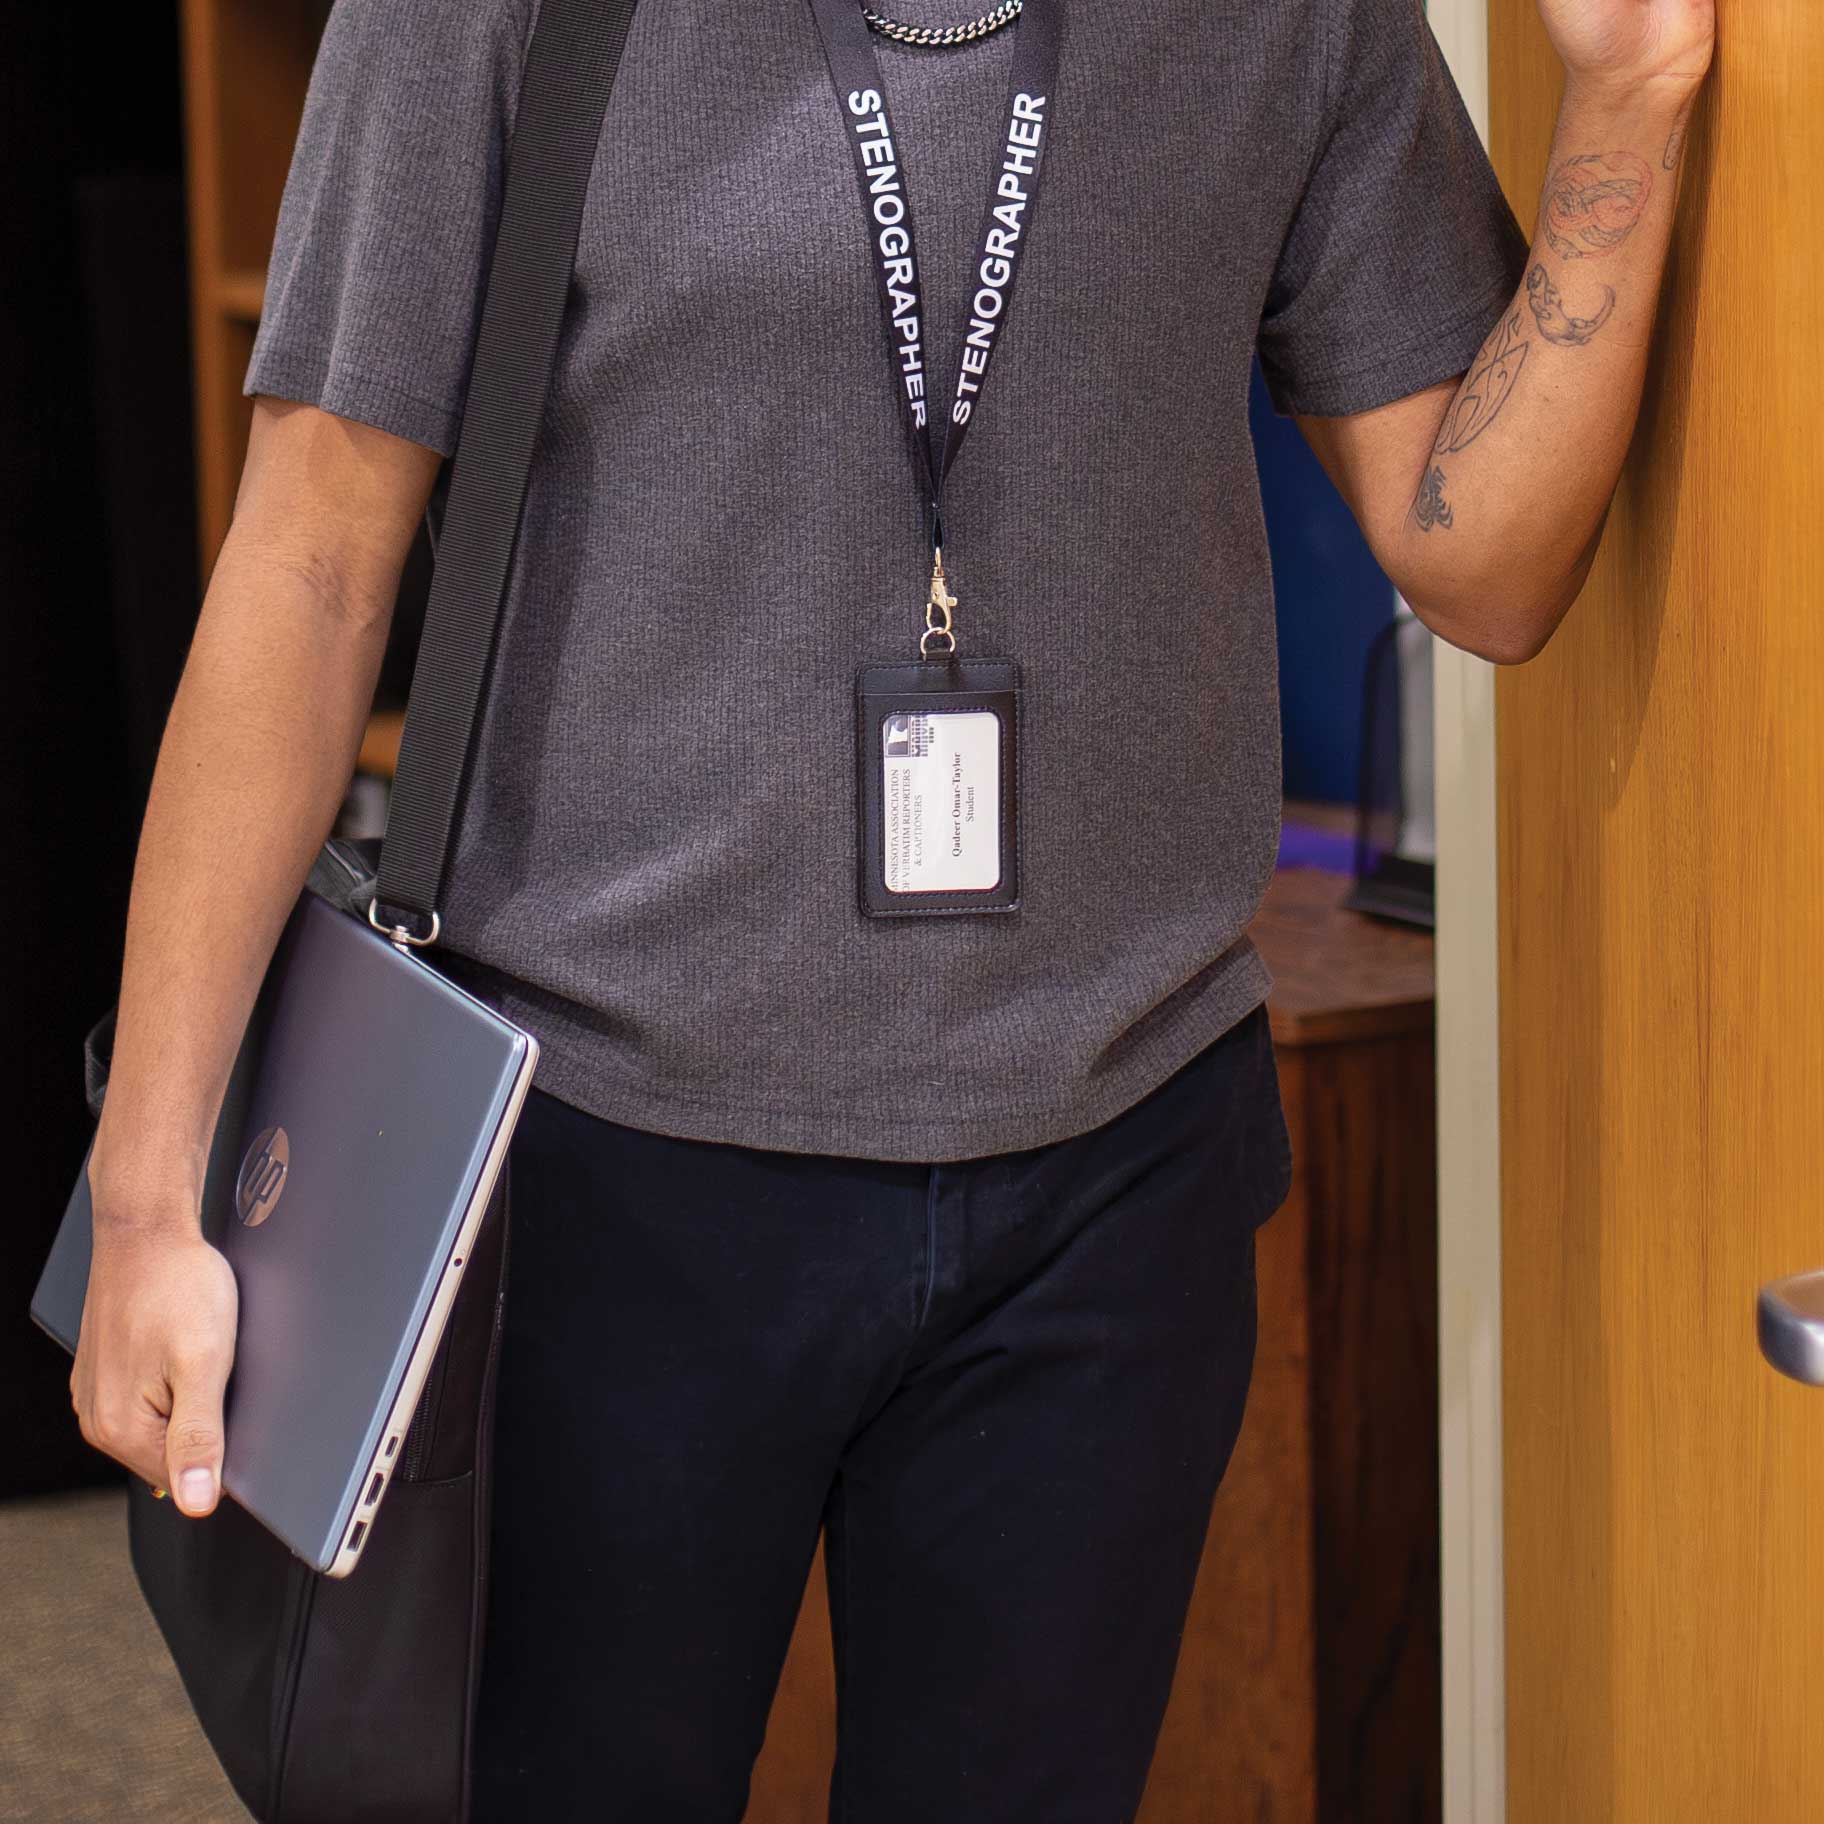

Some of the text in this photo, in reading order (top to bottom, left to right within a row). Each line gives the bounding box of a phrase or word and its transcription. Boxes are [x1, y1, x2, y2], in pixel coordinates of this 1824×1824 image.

[848, 89, 927, 430] STENOGRAPHER
[952, 92, 1046, 426] STENOGRAPHER
[890, 769, 899, 834] ASSOCIATION
[902, 768, 911, 825] REPORTERS
[914, 794, 923, 856] CAPTIONERS
[951, 752, 963, 857] Qadeer Omar-Taylor
[965, 786, 975, 822] Student
[902, 826, 911, 878] VERBATIM
[238, 1128, 288, 1225] hp
